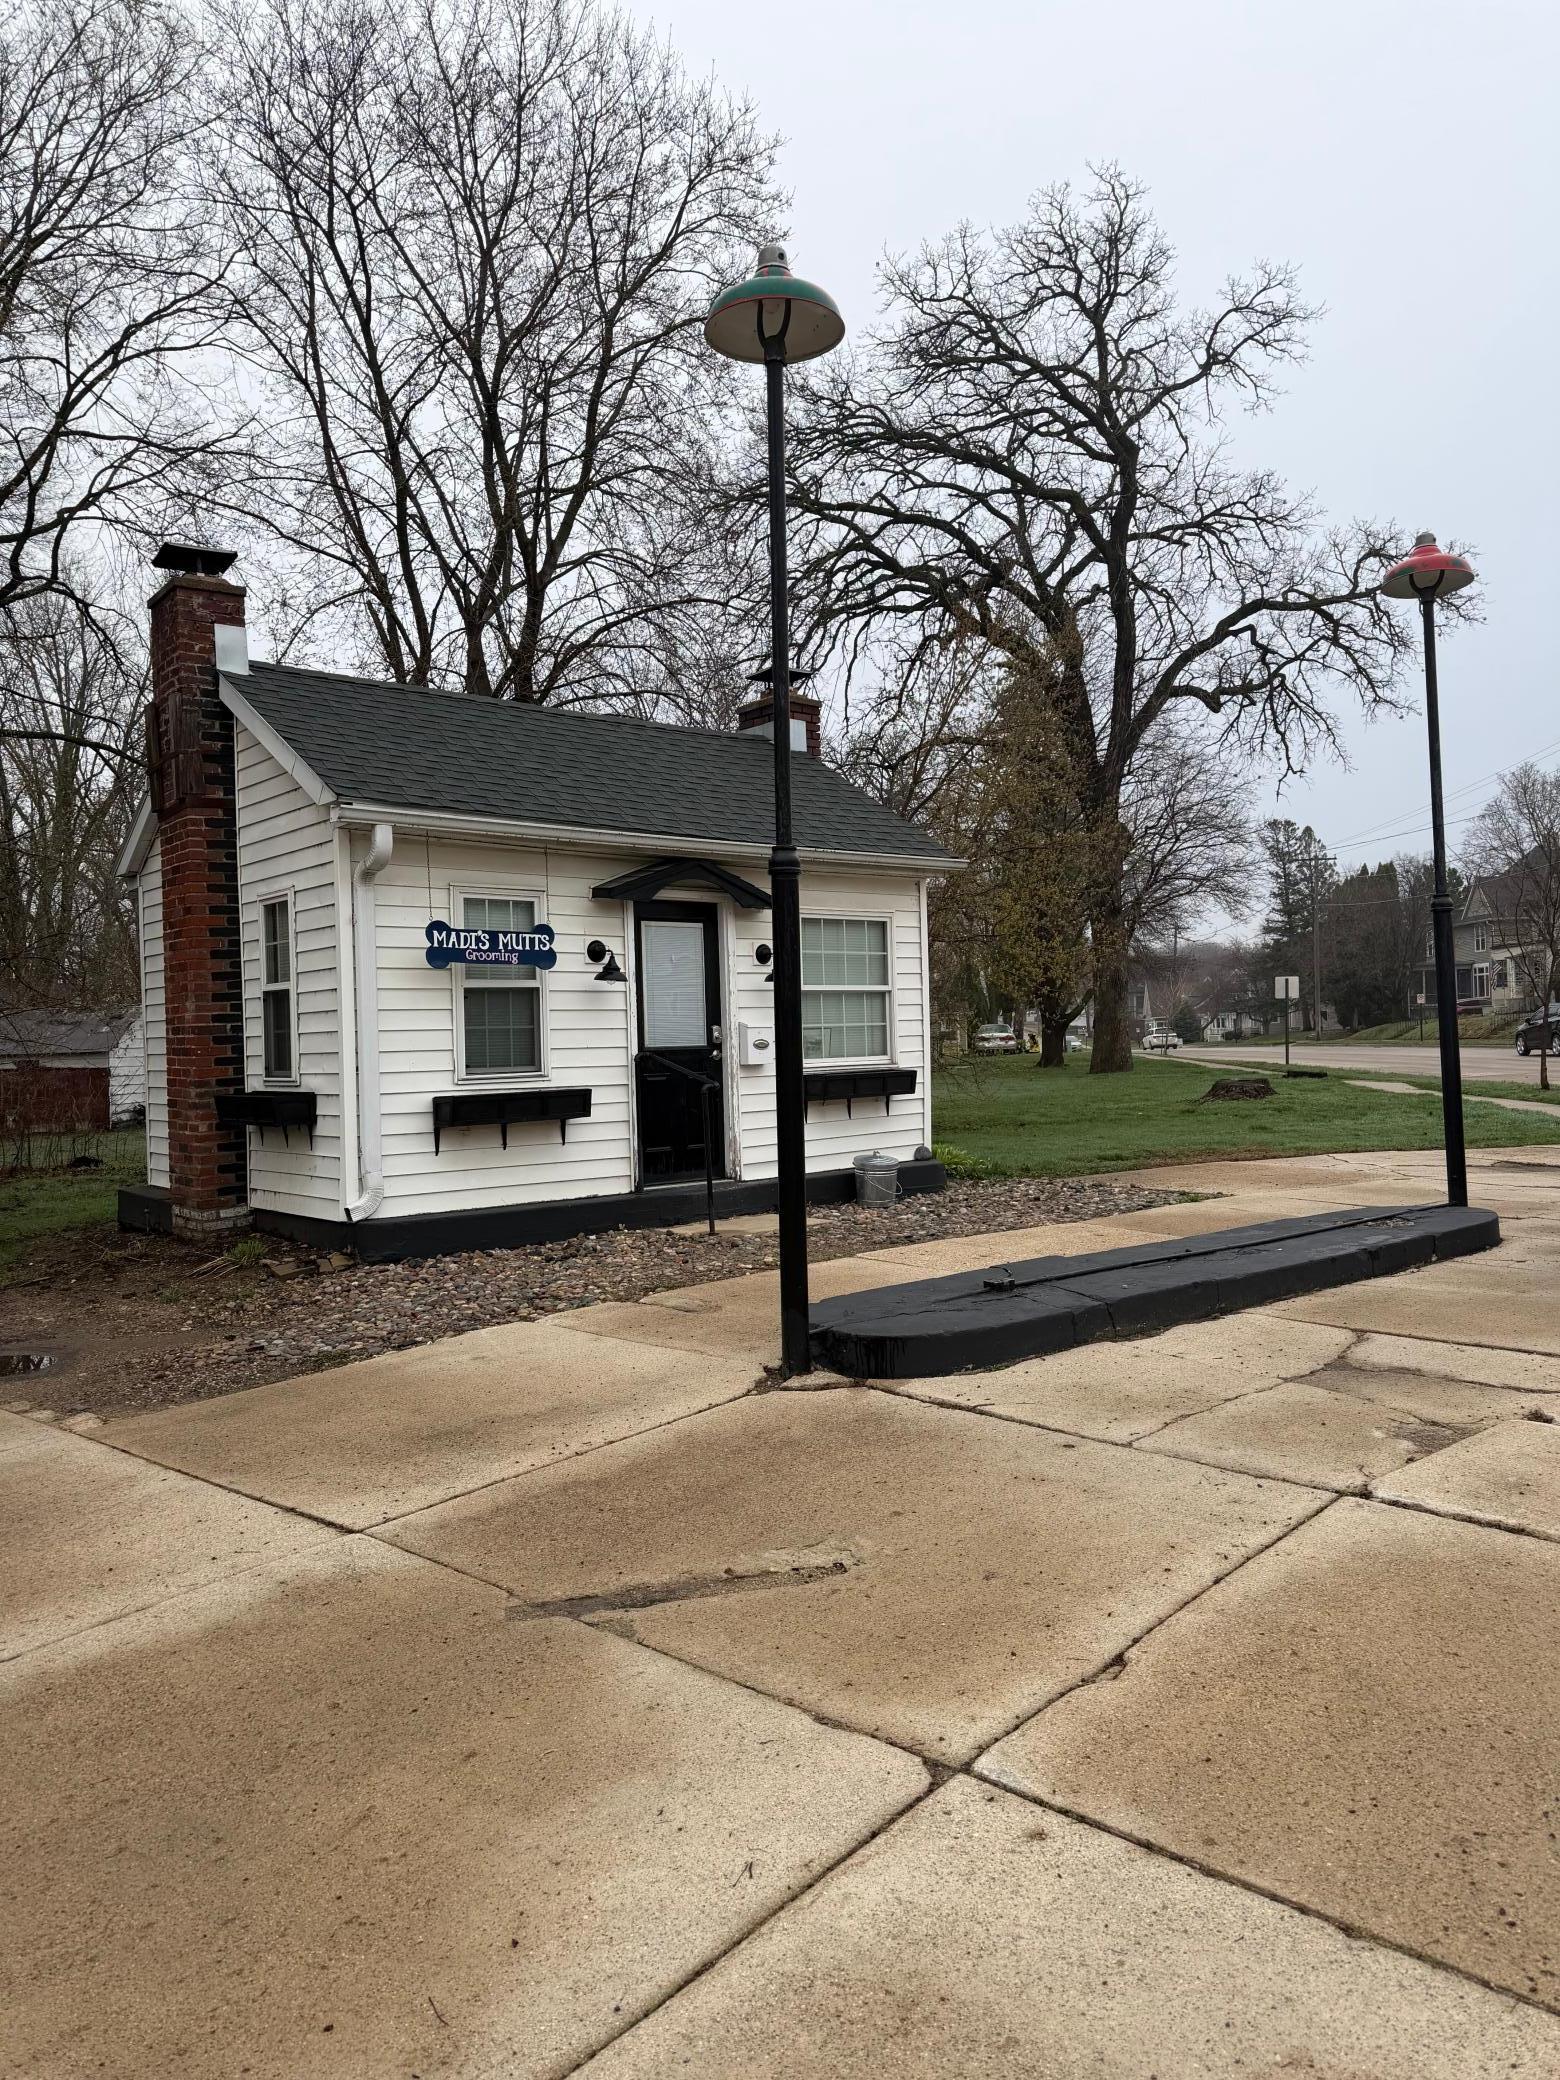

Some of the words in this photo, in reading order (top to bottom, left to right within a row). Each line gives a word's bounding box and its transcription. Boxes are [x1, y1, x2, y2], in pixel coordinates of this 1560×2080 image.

[432, 930, 490, 950] MADI'S
[498, 933, 550, 951] MUTTS
[465, 949, 519, 965] Grooming
